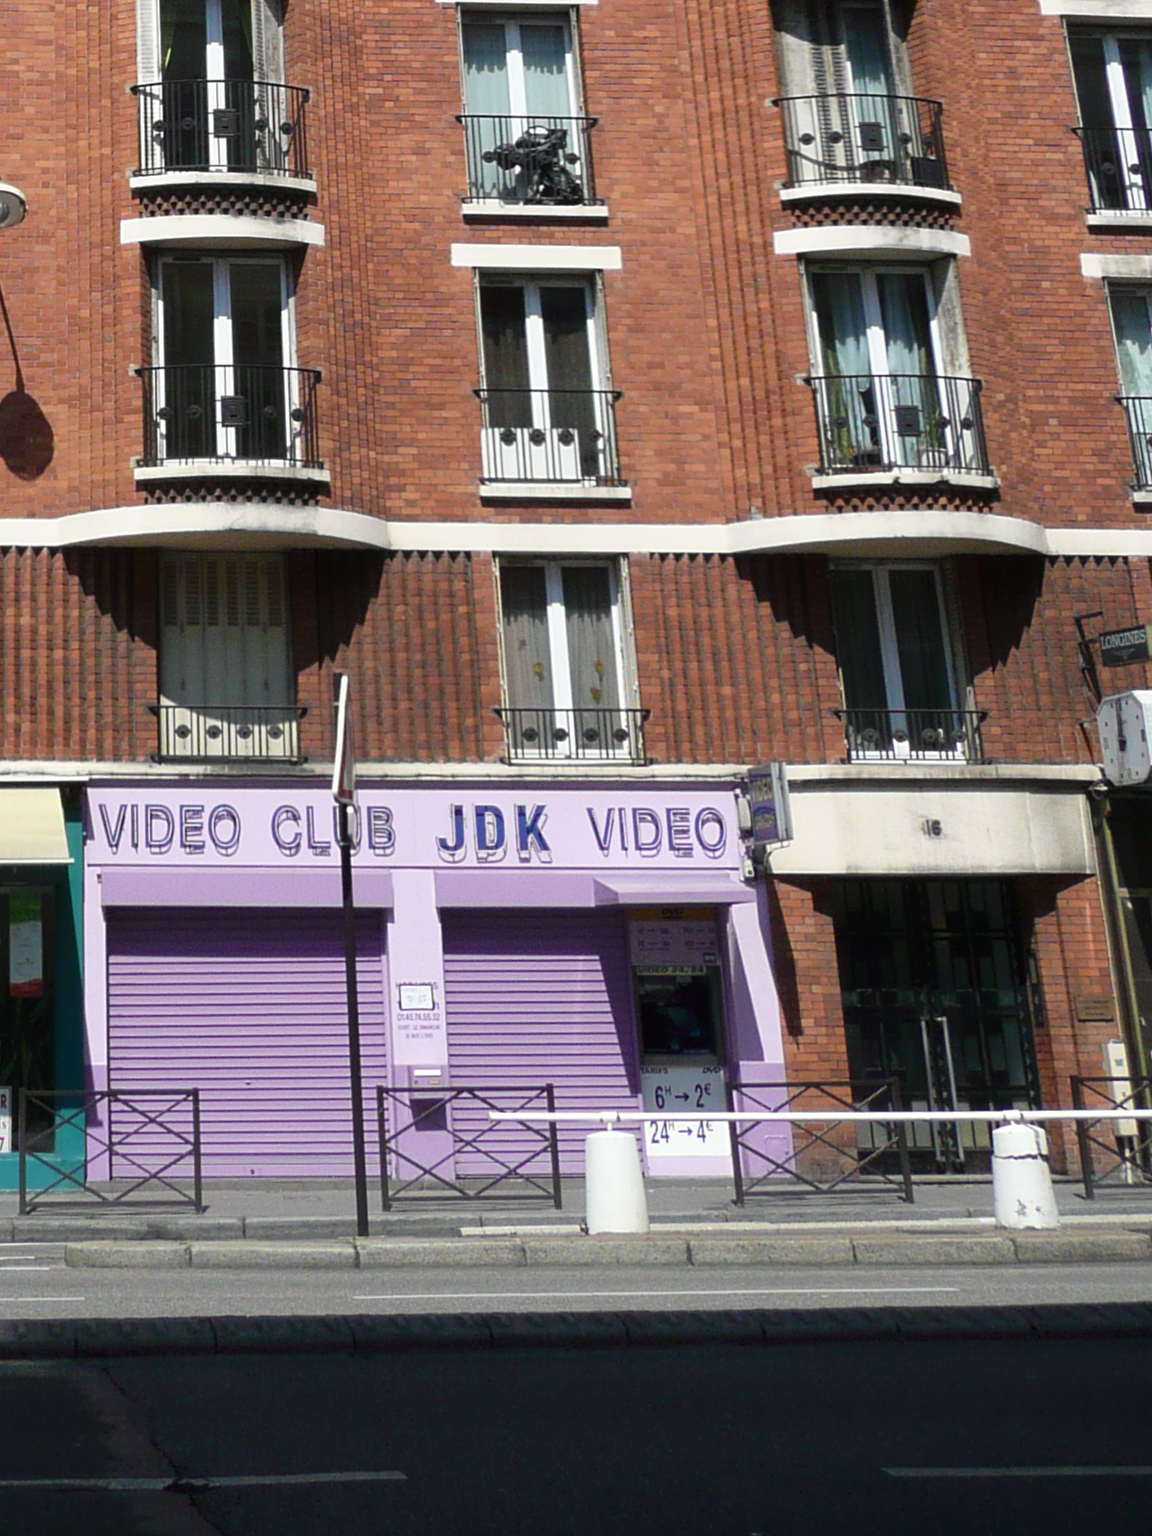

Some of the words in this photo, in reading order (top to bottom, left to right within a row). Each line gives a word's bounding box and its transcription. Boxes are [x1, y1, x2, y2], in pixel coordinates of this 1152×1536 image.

[1100, 629, 1146, 650] LONGINES
[98, 804, 241, 851] VIDEO
[271, 805, 396, 852] CLUB
[436, 804, 551, 857] JDK
[586, 807, 728, 852] VIDEO
[637, 965, 668, 973] VIDEO
